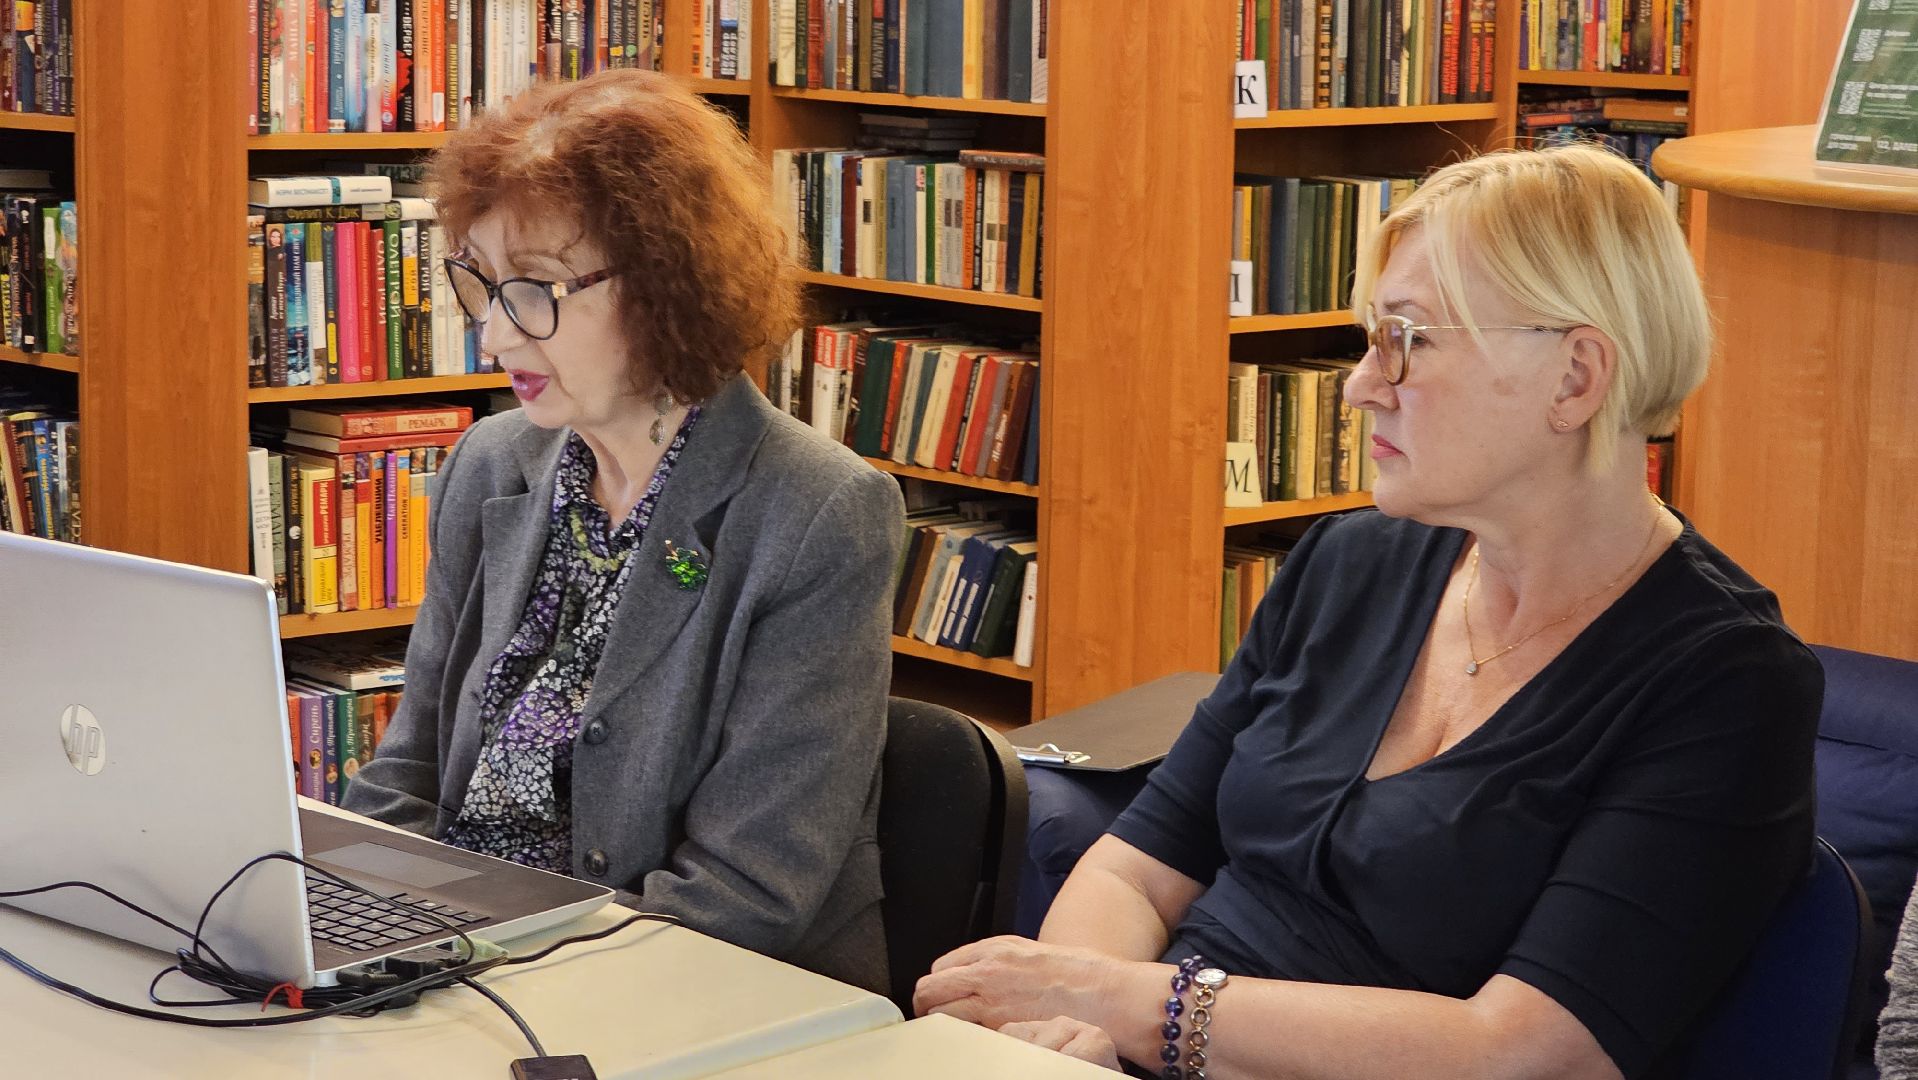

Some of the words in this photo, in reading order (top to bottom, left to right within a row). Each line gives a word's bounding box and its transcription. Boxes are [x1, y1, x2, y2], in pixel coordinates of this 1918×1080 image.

[1236, 74, 1257, 105] К
[389, 233, 400, 278] ОЛЕГ
[420, 231, 428, 261] ОЛЕГ
[421, 267, 430, 292] РОЙ
[389, 281, 401, 318] РОЙ
[409, 417, 446, 429] РЕМАРК
[1225, 458, 1252, 493] М
[319, 482, 328, 515] РЕМАРК
[68, 704, 100, 776] hp
[310, 705, 320, 744] Сирень
